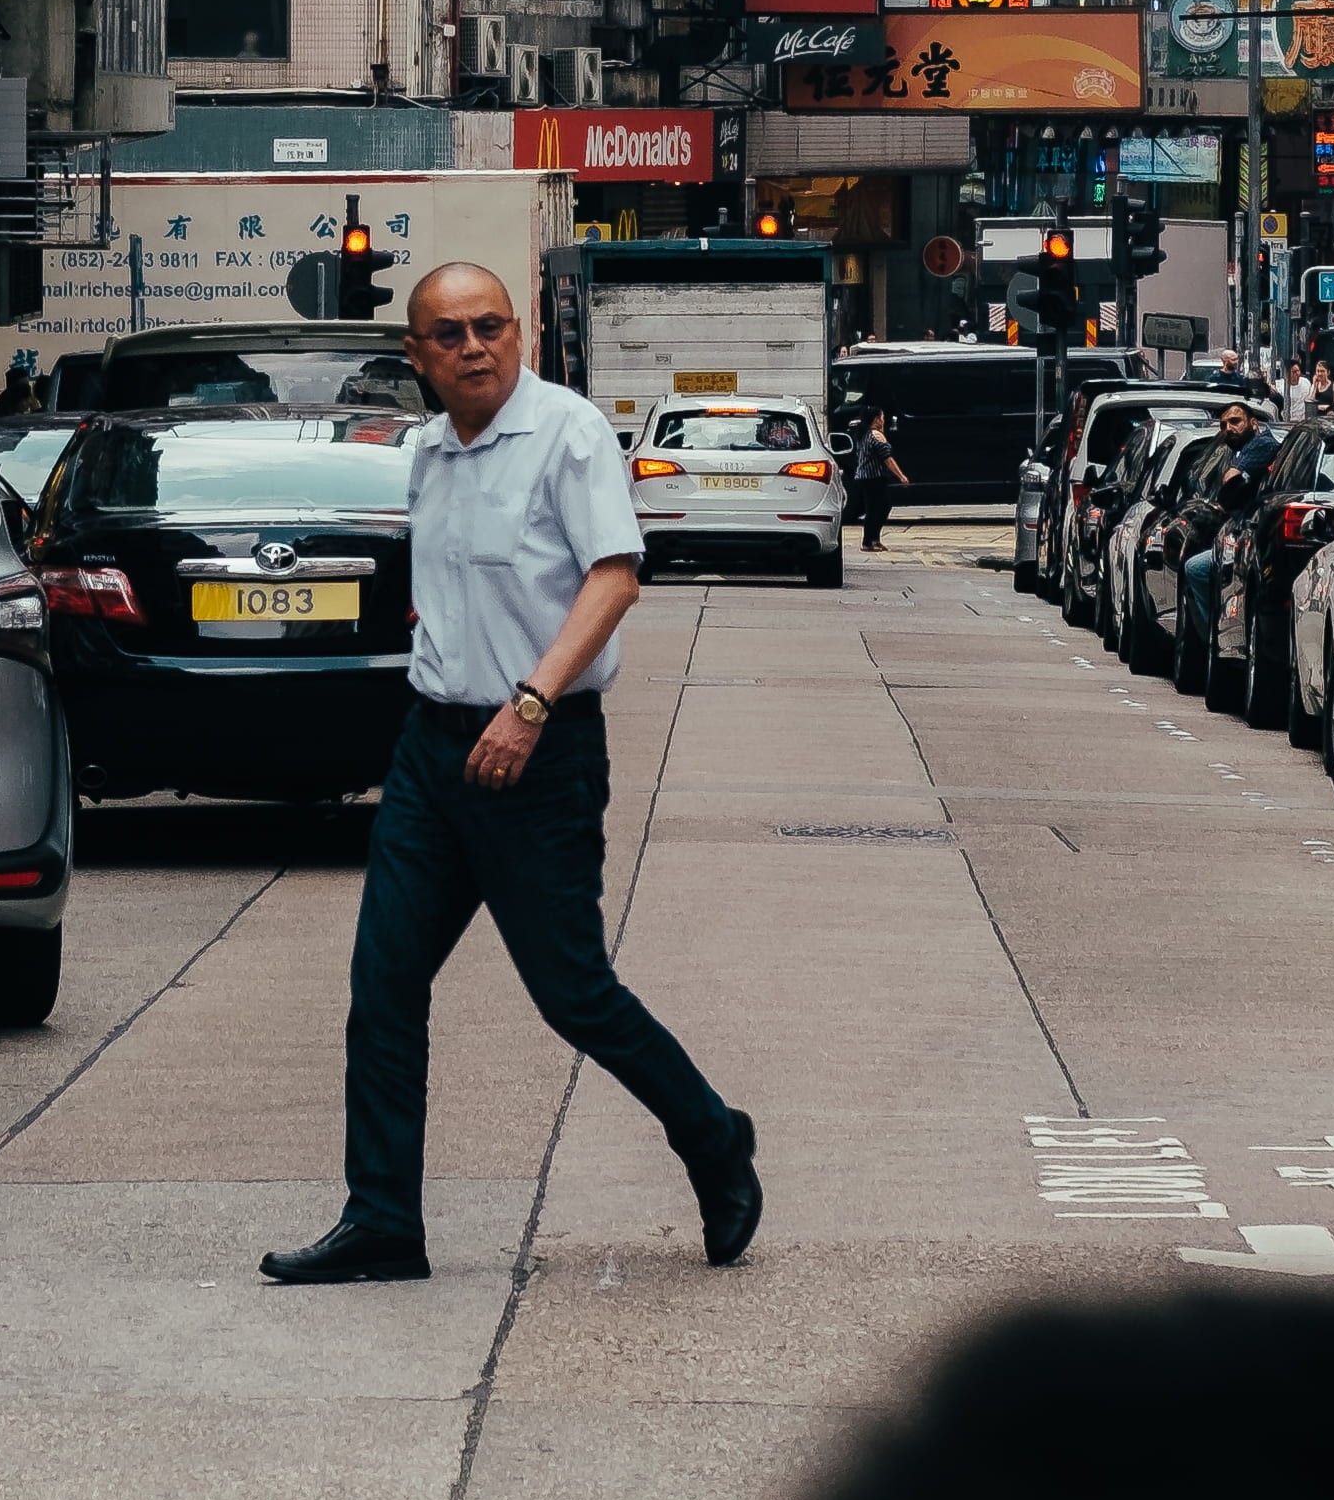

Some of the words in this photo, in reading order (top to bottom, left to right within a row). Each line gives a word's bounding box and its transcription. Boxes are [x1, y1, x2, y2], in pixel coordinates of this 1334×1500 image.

[585, 125, 692, 168] McDonald's
[160, 253, 199, 267] 9811
[215, 252, 253, 267] FAX
[703, 477, 719, 488] TV
[237, 588, 314, 615] 1083
